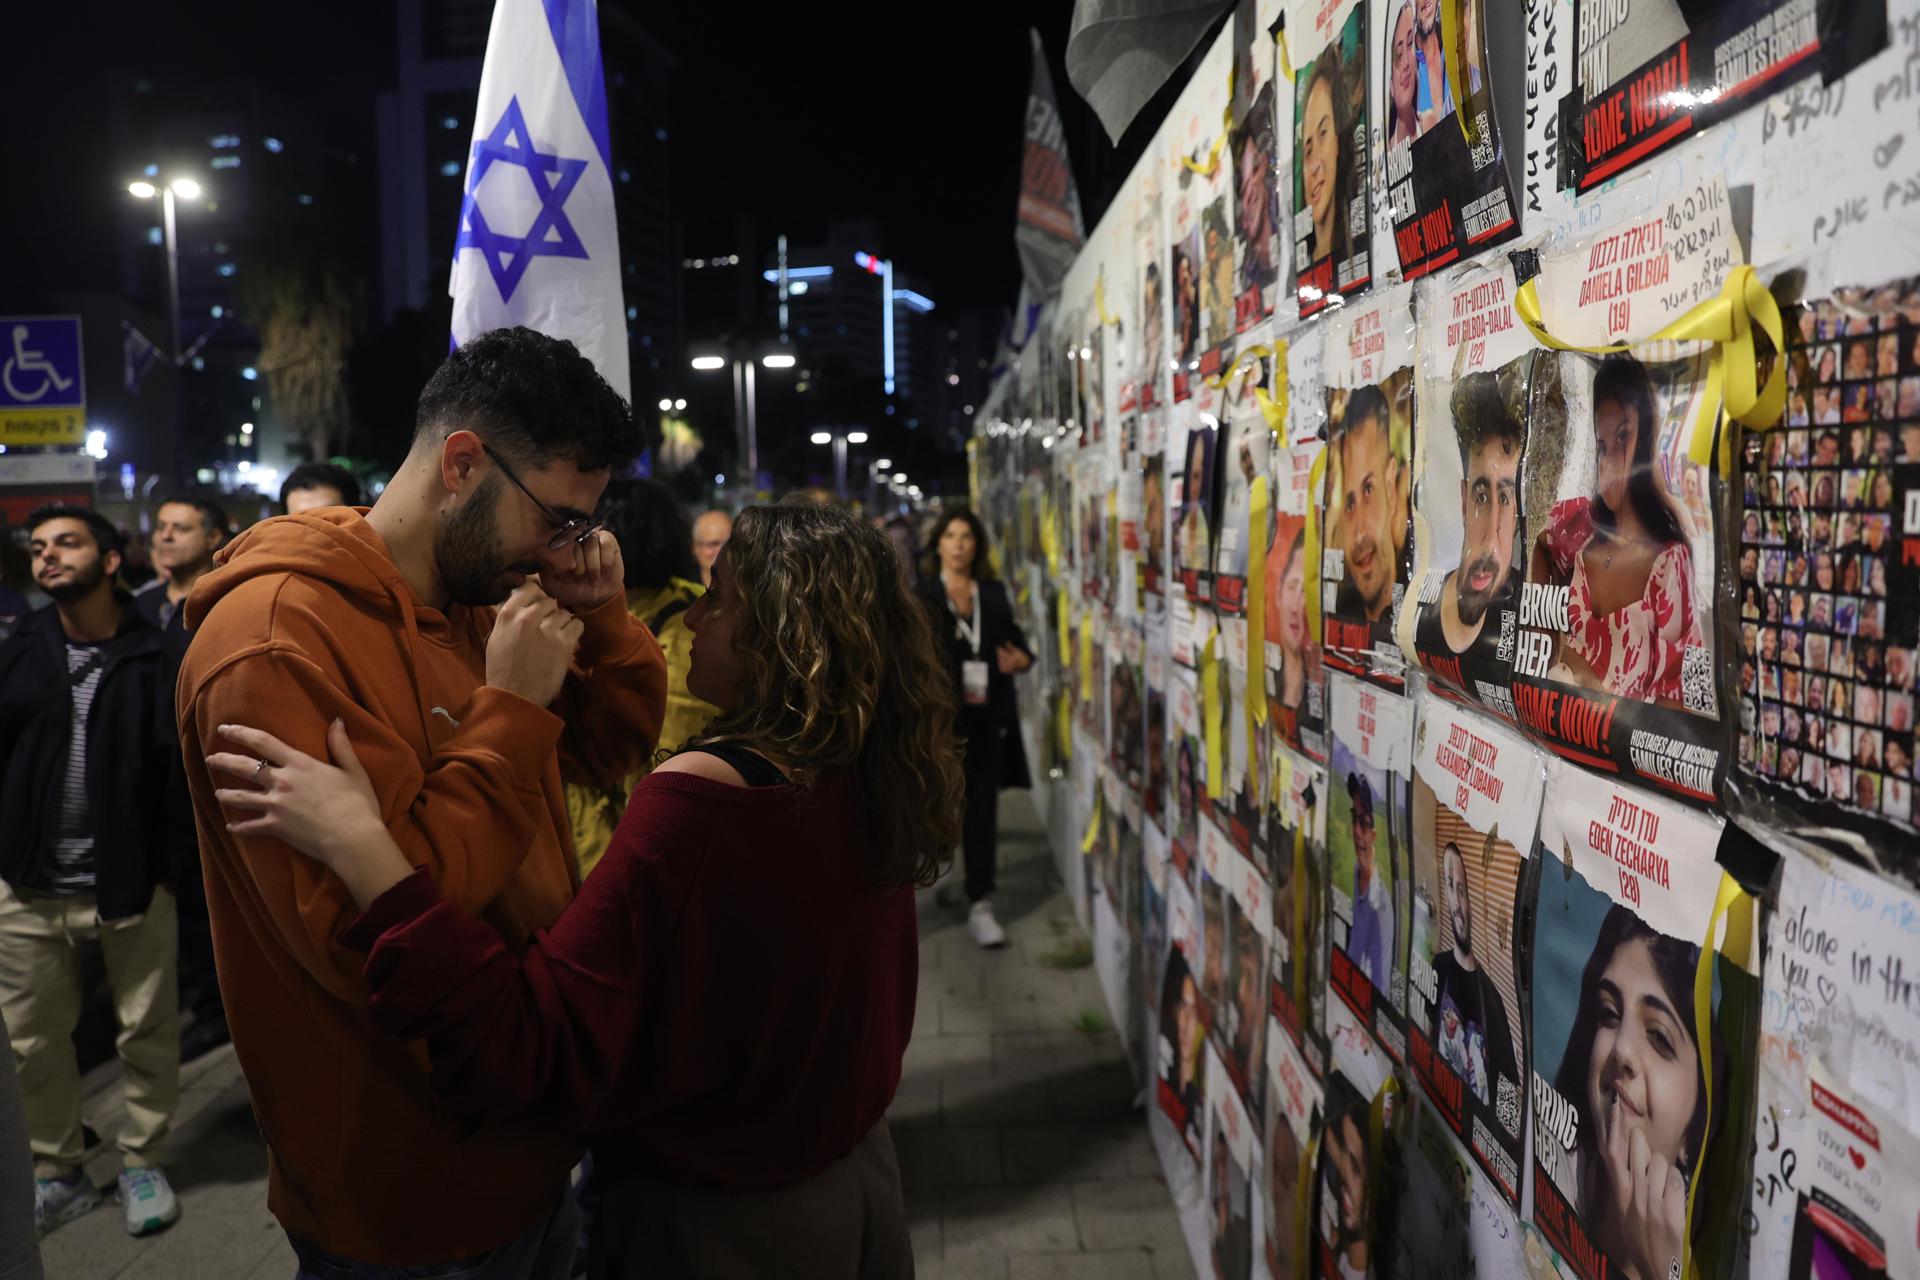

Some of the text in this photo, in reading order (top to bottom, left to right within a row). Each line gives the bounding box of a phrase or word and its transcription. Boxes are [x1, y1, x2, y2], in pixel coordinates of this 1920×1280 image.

[1387, 135, 1413, 188] BRING
[1390, 177, 1416, 225] THEM
[1464, 200, 1512, 240] FAMILIES FORUM
[1395, 198, 1455, 266] HOME NOW!
[1589, 233, 1620, 273] גלבוע
[1620, 218, 1663, 262] דניאלה
[1490, 277, 1505, 305] גיא
[1579, 252, 1669, 308] DANIELA GILBOA
[1447, 304, 1513, 347] GUY GILBOA-DALAL
[1608, 299, 1631, 336] (19)
[1469, 340, 1486, 369] (22)
[1519, 581, 1570, 633] BRING
[1514, 630, 1552, 679] HER
[1513, 681, 1560, 737] HOME
[1559, 694, 1617, 755] NOW!
[1436, 743, 1504, 804] ALEXANDER LOBANOV
[1630, 729, 1718, 769] HOSTAGES AND MISSING
[1630, 746, 1714, 797] FAMILIES FORUM
[1455, 782, 1469, 814] (32)
[1608, 794, 1660, 844] עדן זכריה
[1588, 820, 1670, 890] EDEN ZECHARYA
[1618, 866, 1640, 908] (28)
[1785, 905, 1838, 966] alone
[1533, 1069, 1579, 1150] BRING
[1534, 1116, 1558, 1180] HER
